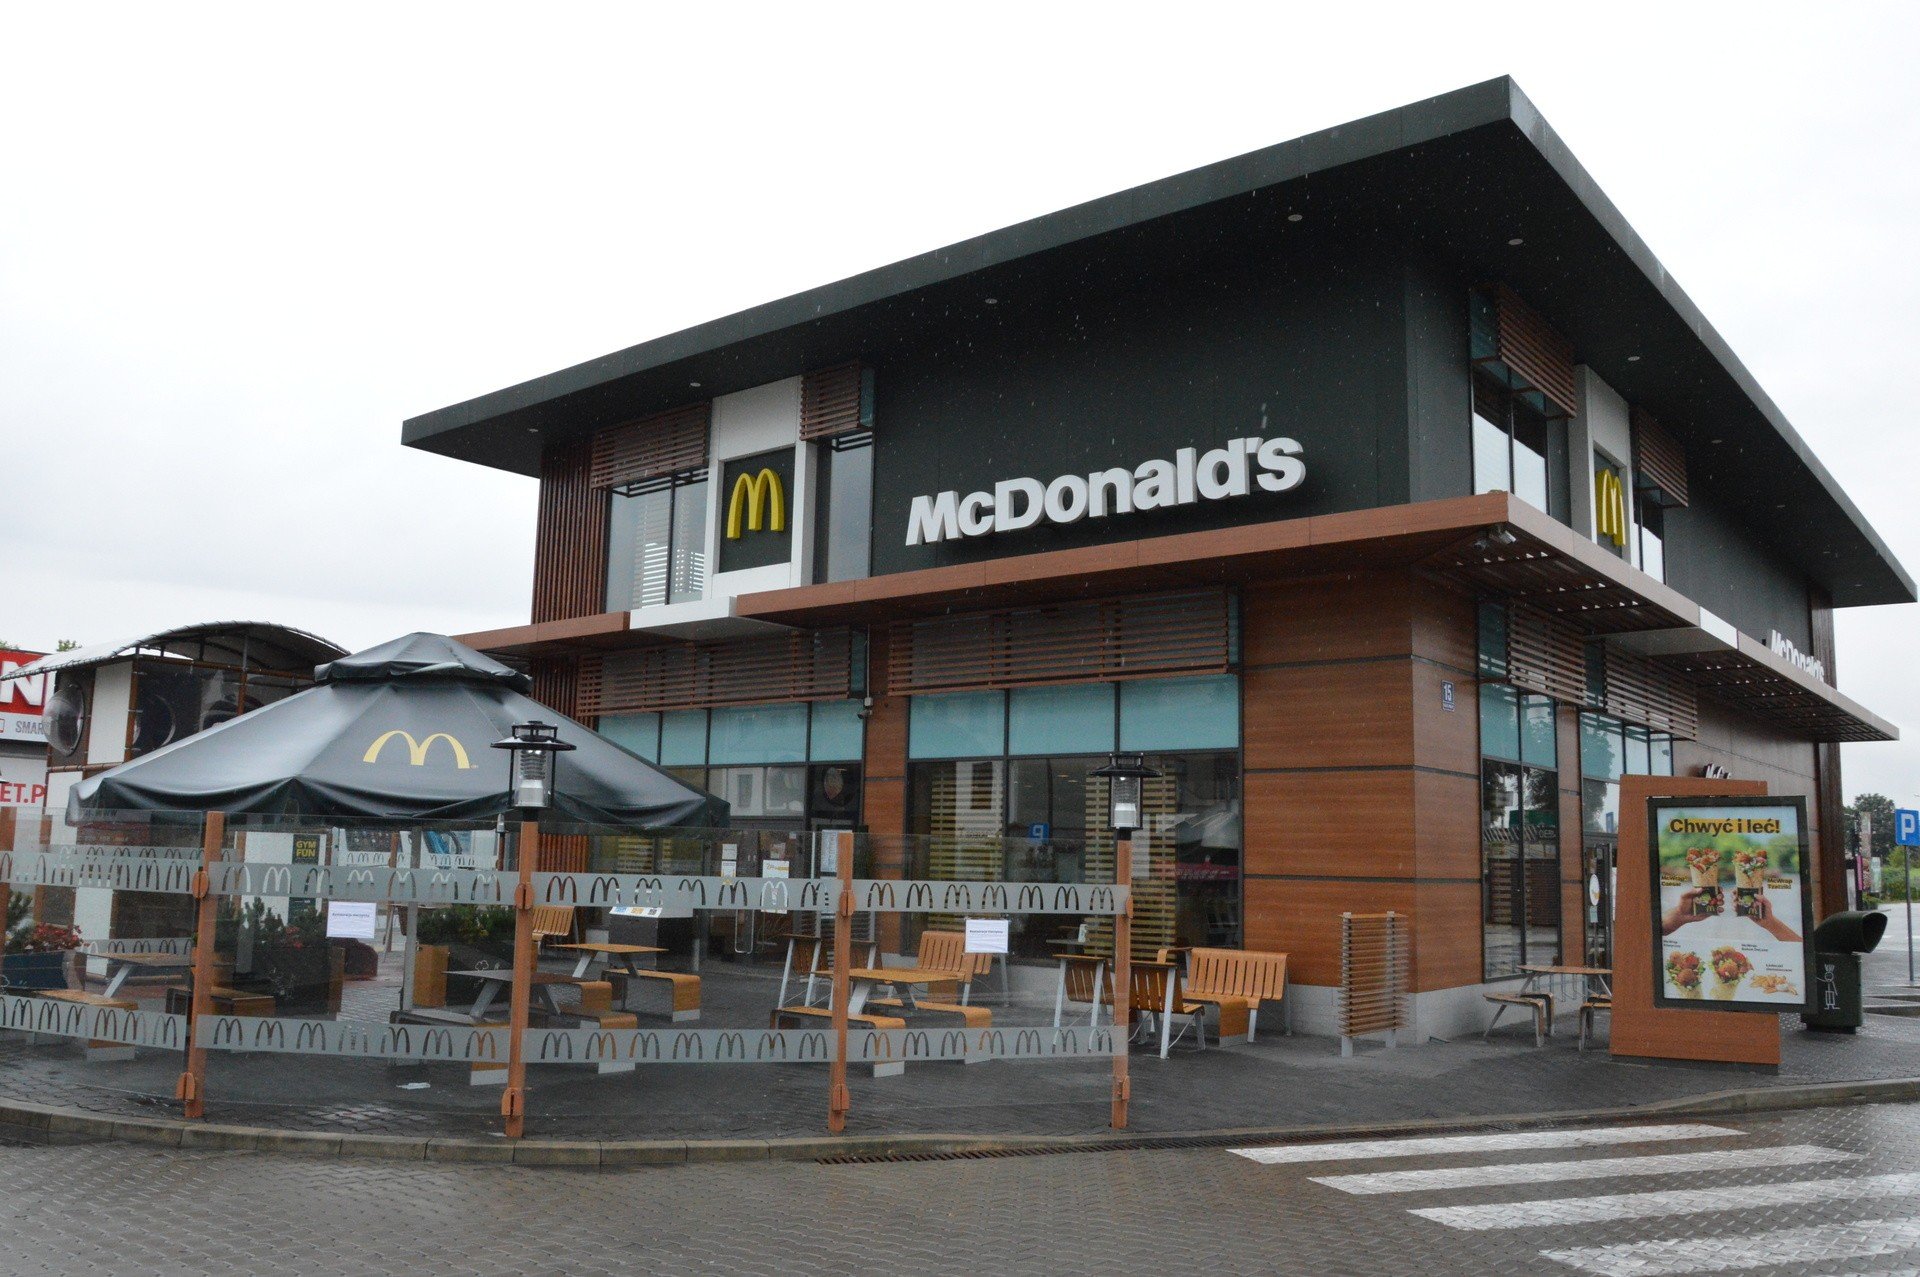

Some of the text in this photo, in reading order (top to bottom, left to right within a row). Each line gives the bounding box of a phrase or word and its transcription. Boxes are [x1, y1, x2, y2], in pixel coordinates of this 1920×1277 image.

[905, 437, 1306, 545] McDonald's
[1443, 683, 1452, 702] 15
[1670, 818, 1781, 837] Chwyć i leć!
[1901, 813, 1915, 840] P
[296, 840, 317, 849] GYM
[296, 849, 316, 857] FUN
